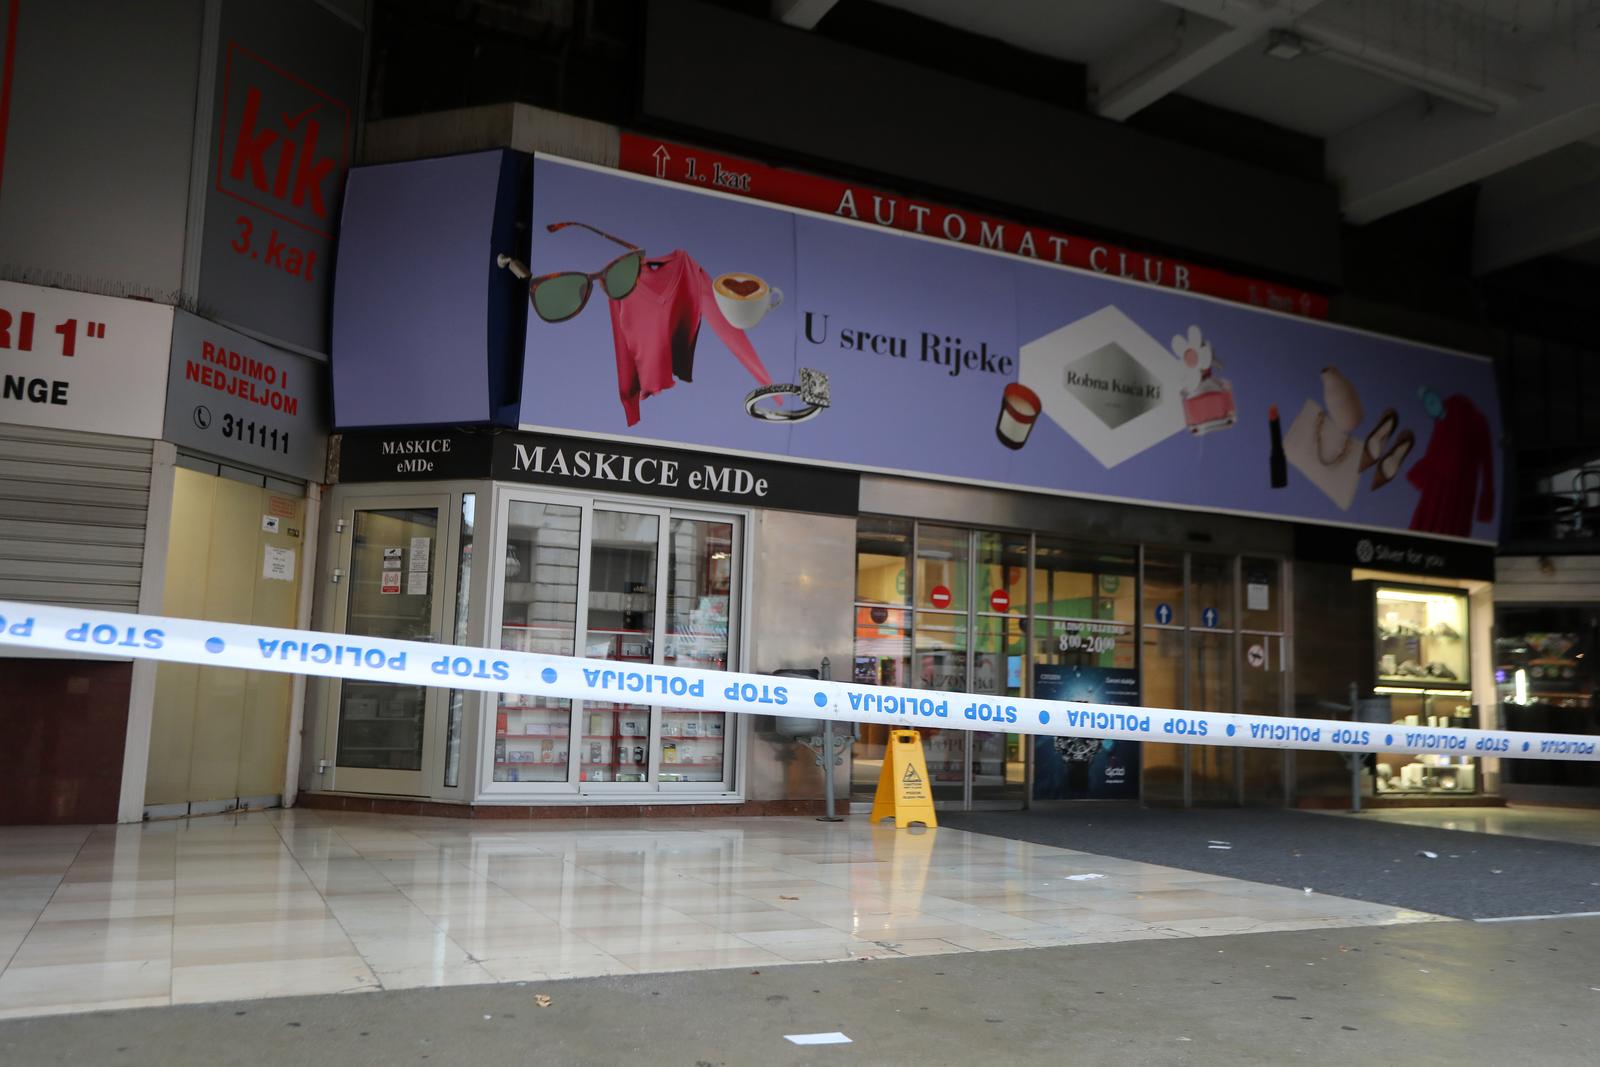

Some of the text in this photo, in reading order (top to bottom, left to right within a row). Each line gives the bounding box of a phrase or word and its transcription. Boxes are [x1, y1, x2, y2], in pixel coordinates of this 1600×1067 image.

[713, 162, 751, 192] kat
[836, 189, 1191, 290] AUTOMAT CLUB
[202, 341, 288, 390] RADIMO I
[803, 311, 1014, 376] U srcu Rijeke
[3, 374, 69, 405] NGE
[185, 360, 298, 416] NEDJELJOM
[1067, 371, 1109, 391] Robna
[222, 413, 289, 454] 311111
[382, 438, 452, 456] MASKICE
[397, 458, 434, 473] eMDe
[511, 443, 769, 498] MASKICE eMDe
[0, 614, 1595, 754] POLICIJA STOP POLICIJA STOP POLICIJA STOP POLICIJA STOP POLICIJA STOP POLICIJA STOP POLICIJA STOP P
